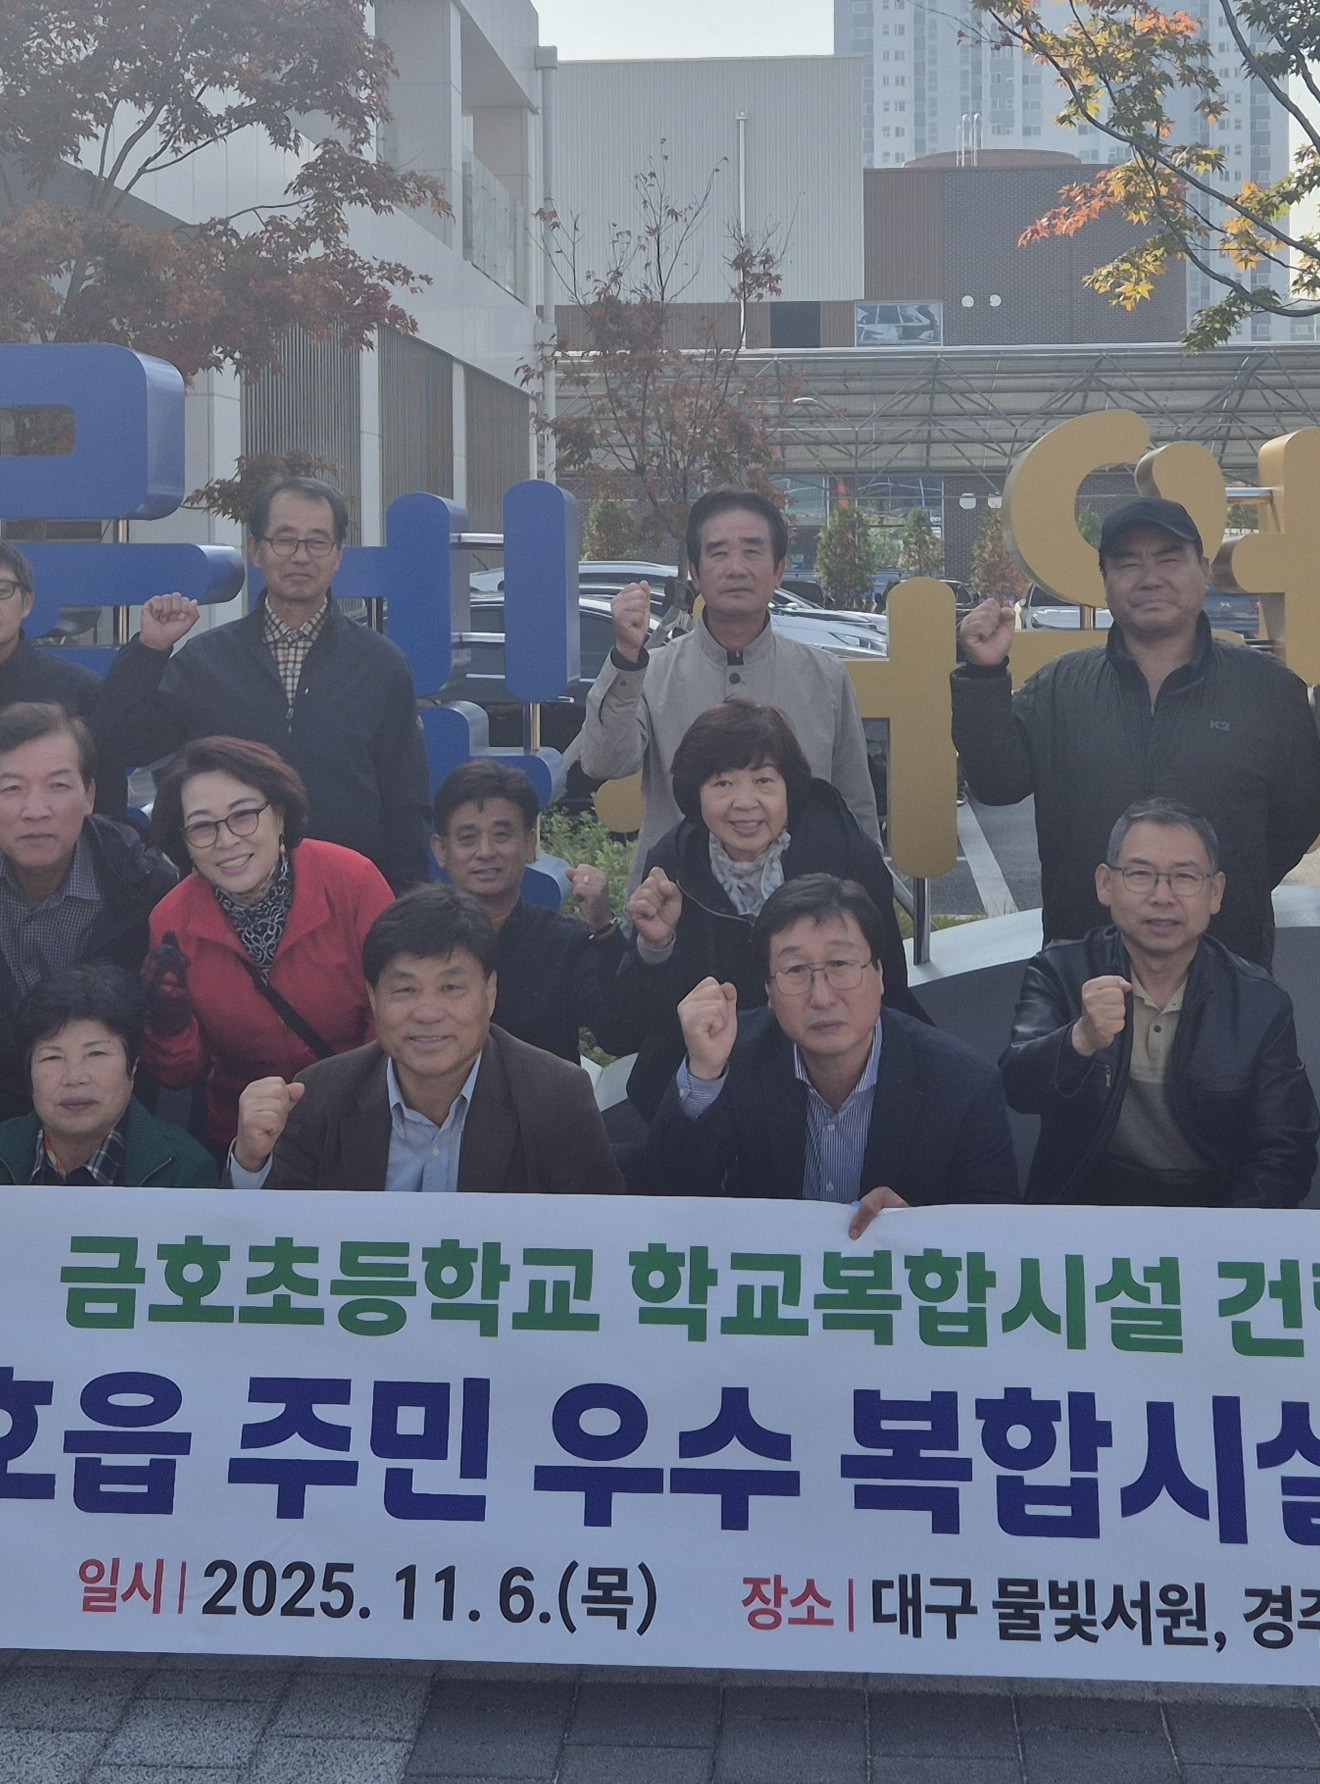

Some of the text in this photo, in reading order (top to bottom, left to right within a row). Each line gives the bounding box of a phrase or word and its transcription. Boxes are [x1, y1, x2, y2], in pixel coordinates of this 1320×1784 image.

[1209, 719, 1231, 732] K2
[60, 1235, 600, 1337] 금호초등학교
[629, 1243, 1183, 1353] 학교복합시설
[228, 1377, 490, 1522] 주민
[534, 1383, 800, 1531] 우수
[202, 1559, 370, 1619] 2025.
[395, 1564, 480, 1622] 11.
[872, 1574, 978, 1639] 대구
[992, 1578, 1226, 1653] 물빛서원,
